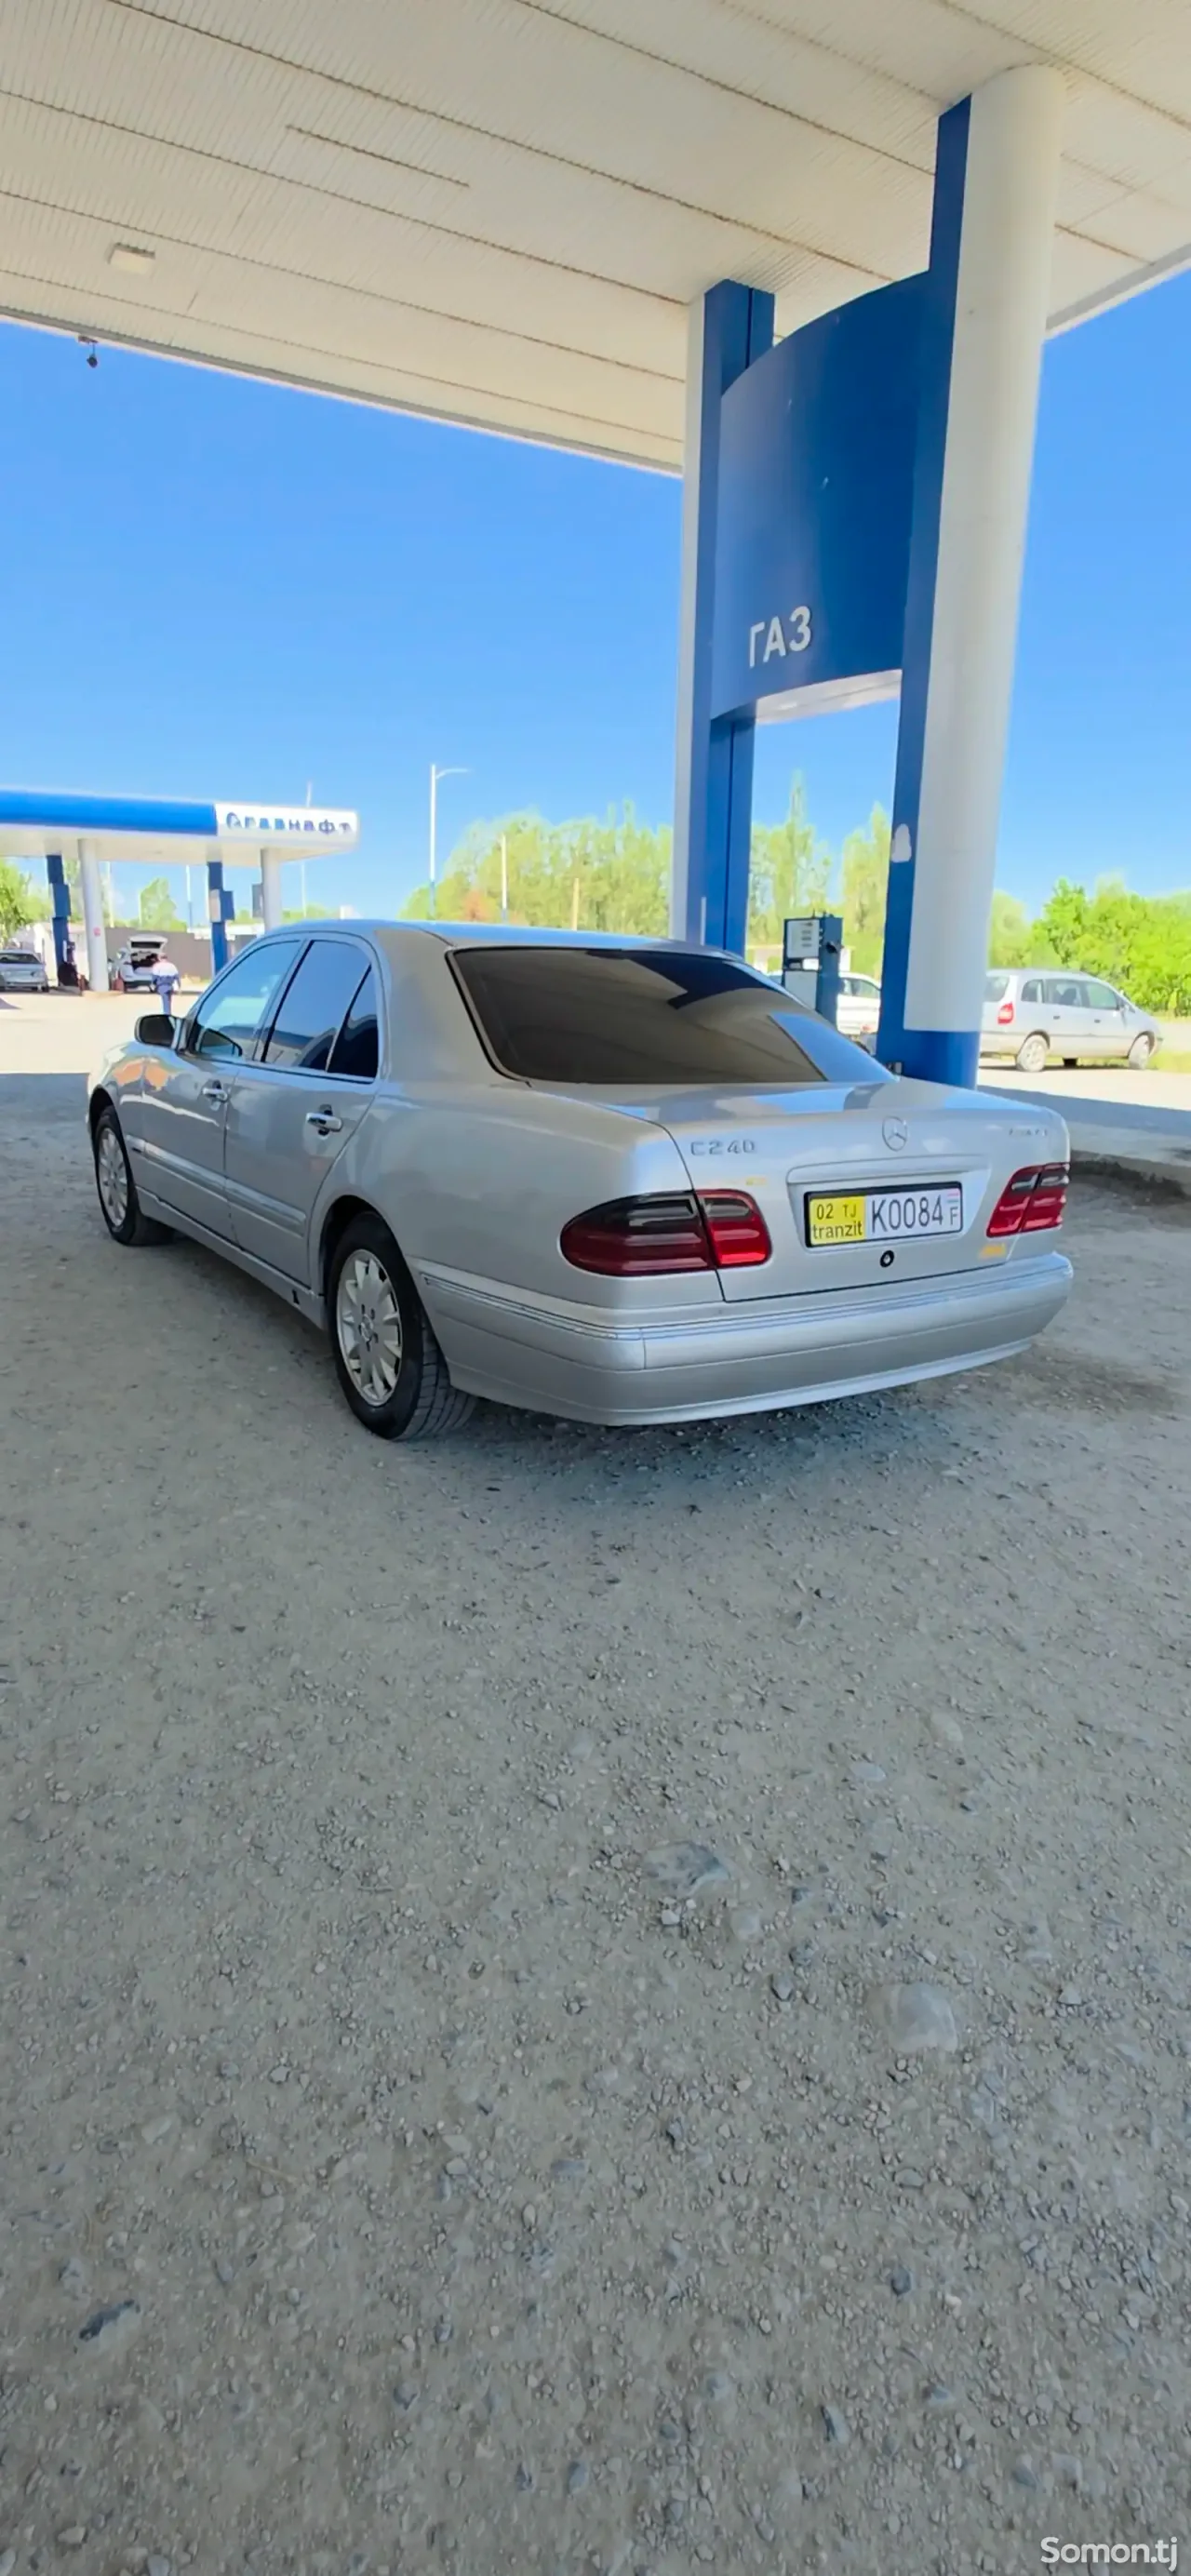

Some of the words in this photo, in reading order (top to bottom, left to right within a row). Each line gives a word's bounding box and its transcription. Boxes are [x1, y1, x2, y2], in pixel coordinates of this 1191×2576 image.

[749, 606, 811, 668] ГАЗ
[816, 1203, 835, 1221] 02
[843, 1204, 857, 1218] TJ
[872, 1195, 943, 1233] K0084
[950, 1207, 958, 1225] F
[812, 1221, 863, 1239] tranzit
